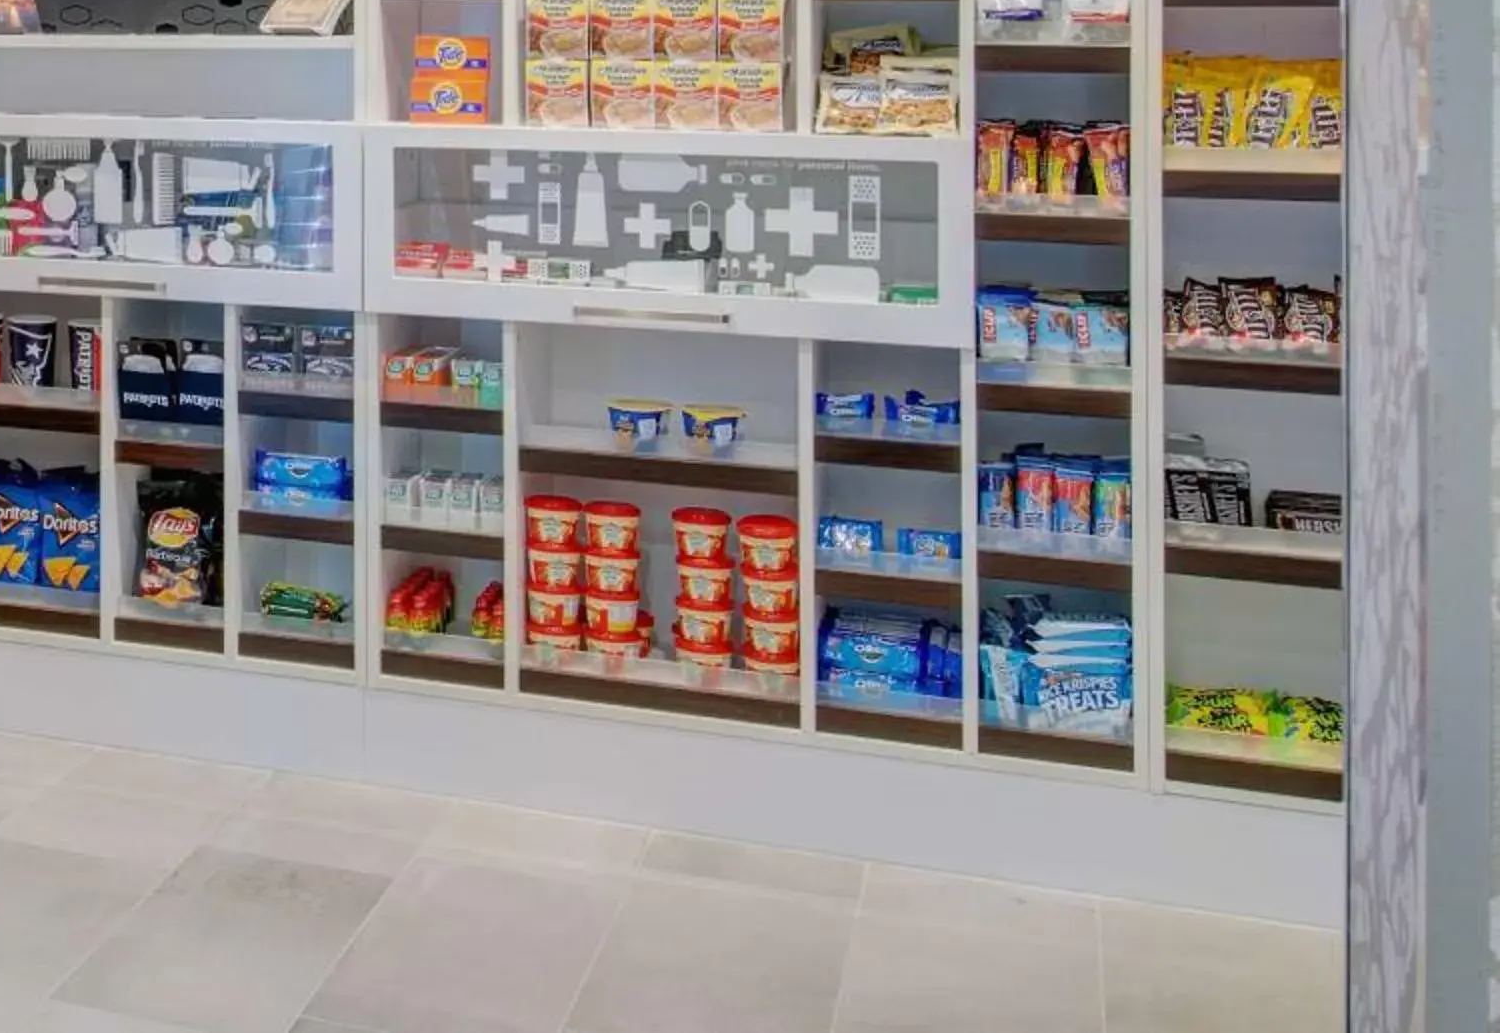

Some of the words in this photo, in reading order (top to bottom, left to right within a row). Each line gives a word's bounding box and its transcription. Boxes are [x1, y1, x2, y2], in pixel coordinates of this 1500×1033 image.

[123, 391, 170, 408] PATRIOTS
[42, 513, 98, 535] Doritos
[1040, 689, 1119, 716] TREATS
